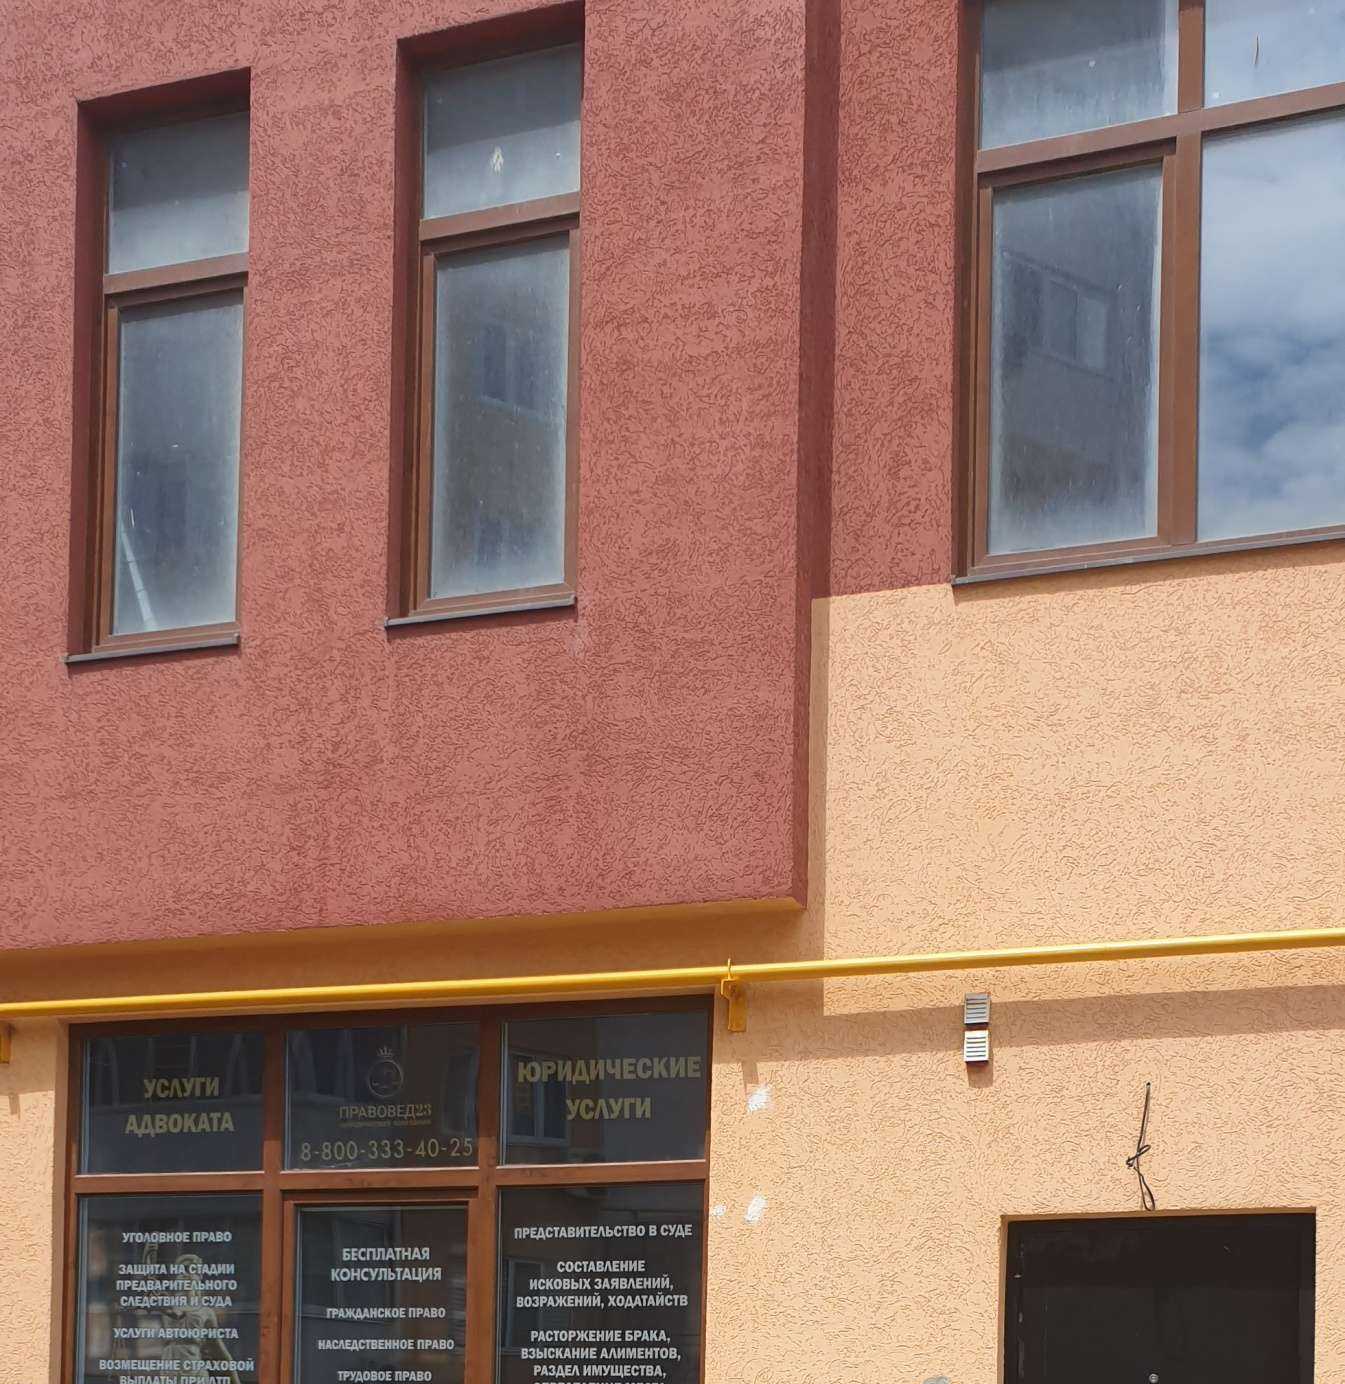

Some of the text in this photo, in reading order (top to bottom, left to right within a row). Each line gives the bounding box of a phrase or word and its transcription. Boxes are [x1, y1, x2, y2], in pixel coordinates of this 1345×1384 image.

[518, 1056, 700, 1084] ЮРИДИЧЕСКИЕ
[144, 1077, 219, 1098] УСЛУГИ
[340, 1104, 432, 1120] ПРАВОВЕД23
[566, 1098, 650, 1120] УСЛУГИ
[125, 1112, 234, 1138] АДВОКАТА
[302, 1138, 472, 1161] 8-800-333-40-25
[122, 1232, 232, 1242] УГОЛОВНОЕ ПРАВО
[514, 1224, 692, 1240] ПРЕДСТАВИТЕЛЬСТВО В СУДЕ
[342, 1248, 430, 1260] БЕСПЛАТНАЯ
[118, 1264, 234, 1276] ЗАЩИТА НА СТАДИИ
[557, 1261, 646, 1272] СОСТАВЛЕНИЕ
[331, 1268, 442, 1282] КОНСУЛЬТАЦИЯ
[116, 1280, 237, 1292] ПРЕДВАРИТЕЛЬНОГО
[530, 1274, 674, 1291] ИСКОВЫХ ЗАЯВЛЕНИЙ,
[120, 1296, 232, 1307] СЛЕДСТВИЯ И СУДА
[516, 1292, 688, 1309] ВОЗРАЖЕНИЙ, ХОДАТАЙСТВ
[326, 1308, 446, 1320] ГРАЖДАНСКОЕ ПРАВО
[113, 1328, 239, 1338] УСЛУГИ АВТОЮРИСТА
[531, 1330, 670, 1344] РАСТОРЖЕНИЕ БРАКА,
[318, 1340, 454, 1351] НАСЛЕДСТВЕННОЕ ПРАВО
[521, 1348, 681, 1361] ВЗЫСКАНИЕ АЛИМЕНТОВ,
[100, 1358, 254, 1371] ВОЗМЕЩЕНИЕ СТРАХОВОЙ
[337, 1371, 432, 1382] ТРУДОВОЕ ПРАВО
[534, 1365, 666, 1378] РАЗДЕЛ ИМУЩЕСТВА,
